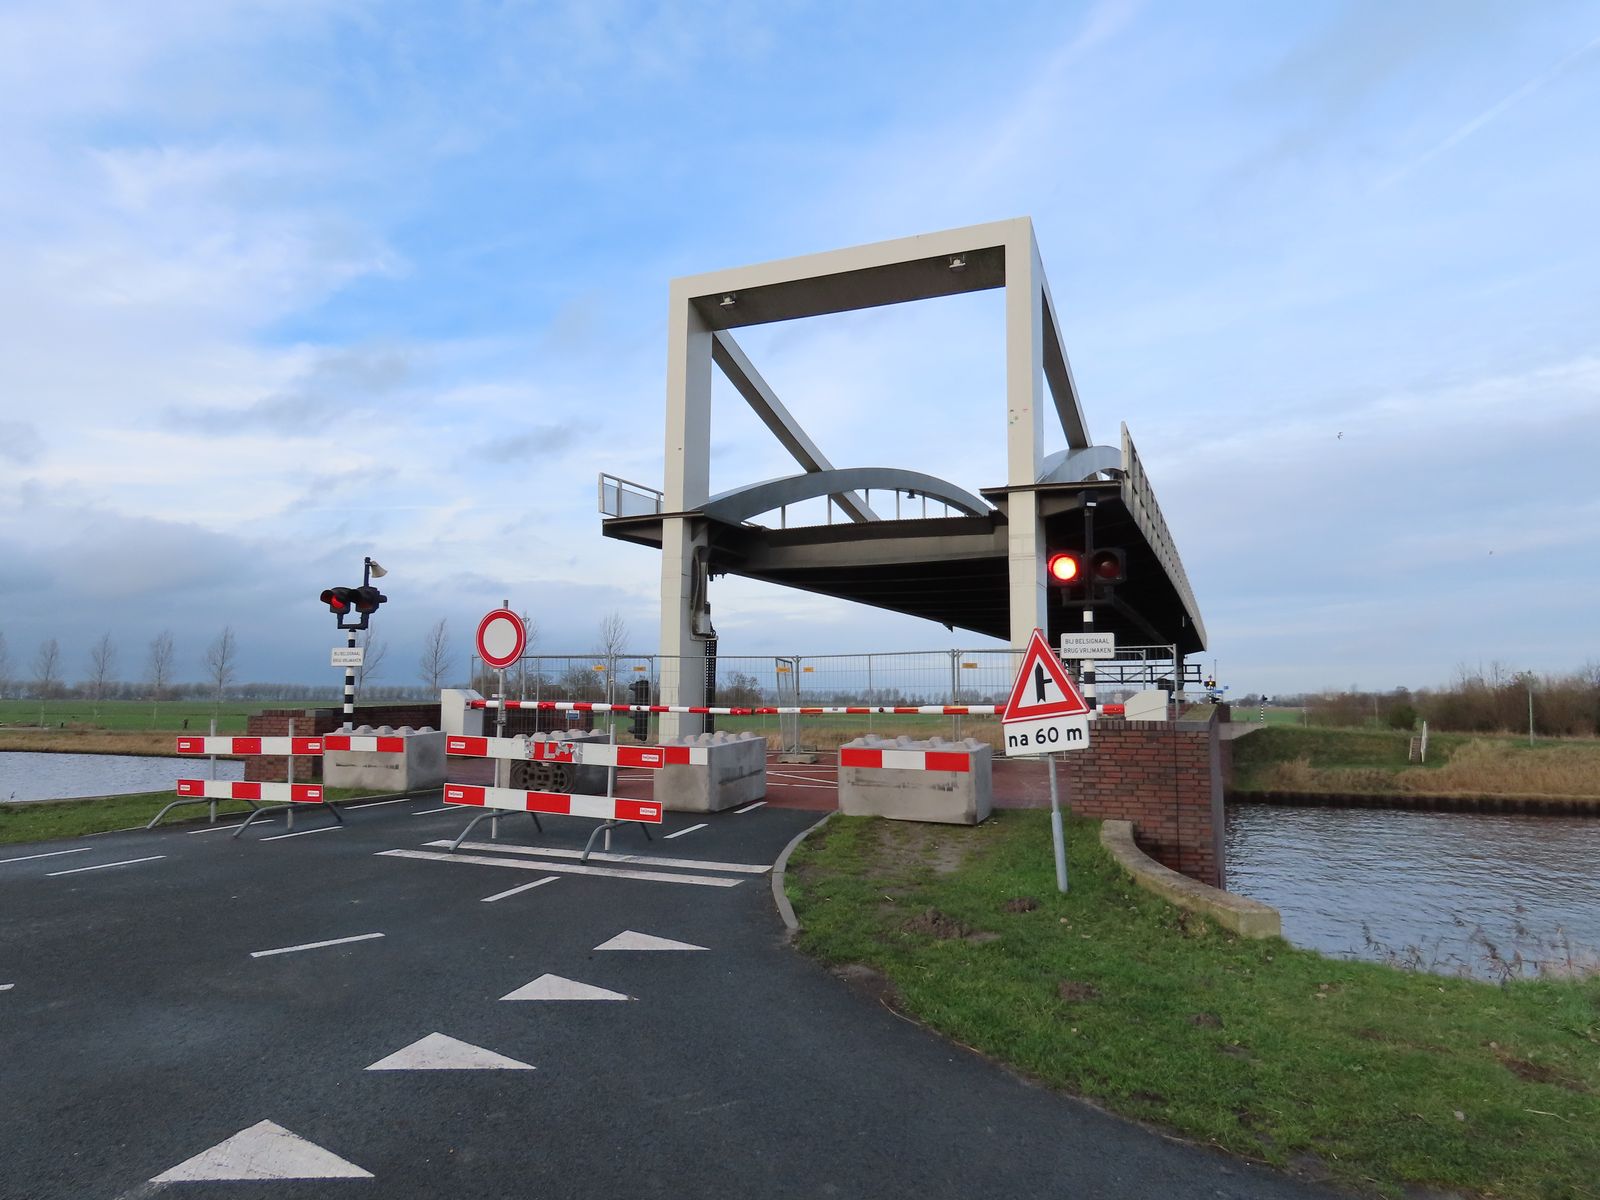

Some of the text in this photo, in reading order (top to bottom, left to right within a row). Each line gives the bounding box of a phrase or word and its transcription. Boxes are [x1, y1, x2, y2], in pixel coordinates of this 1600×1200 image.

[1009, 726, 1083, 747] na 60 m
